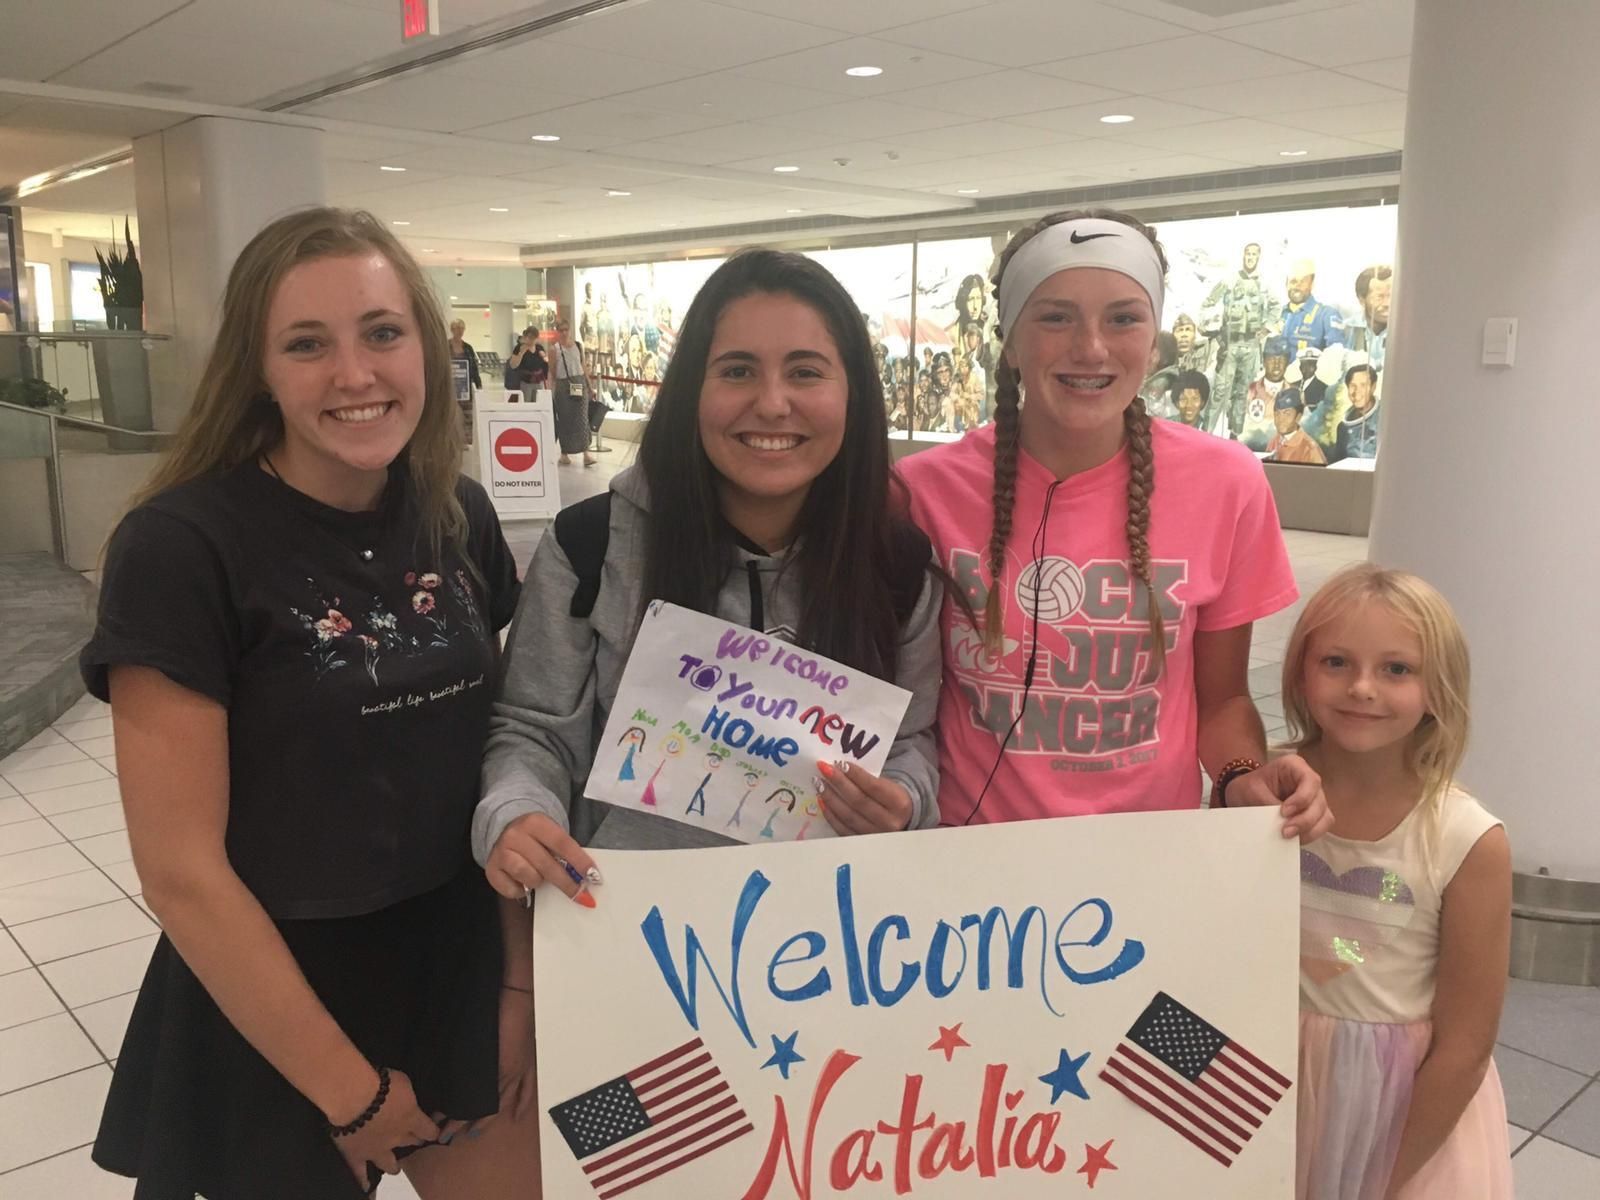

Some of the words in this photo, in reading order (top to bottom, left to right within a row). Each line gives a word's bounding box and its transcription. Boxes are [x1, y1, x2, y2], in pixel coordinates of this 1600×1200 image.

[407, 694, 424, 707] life
[640, 862, 1145, 1050] Welcome
[741, 1048, 1066, 1200] Natalia
